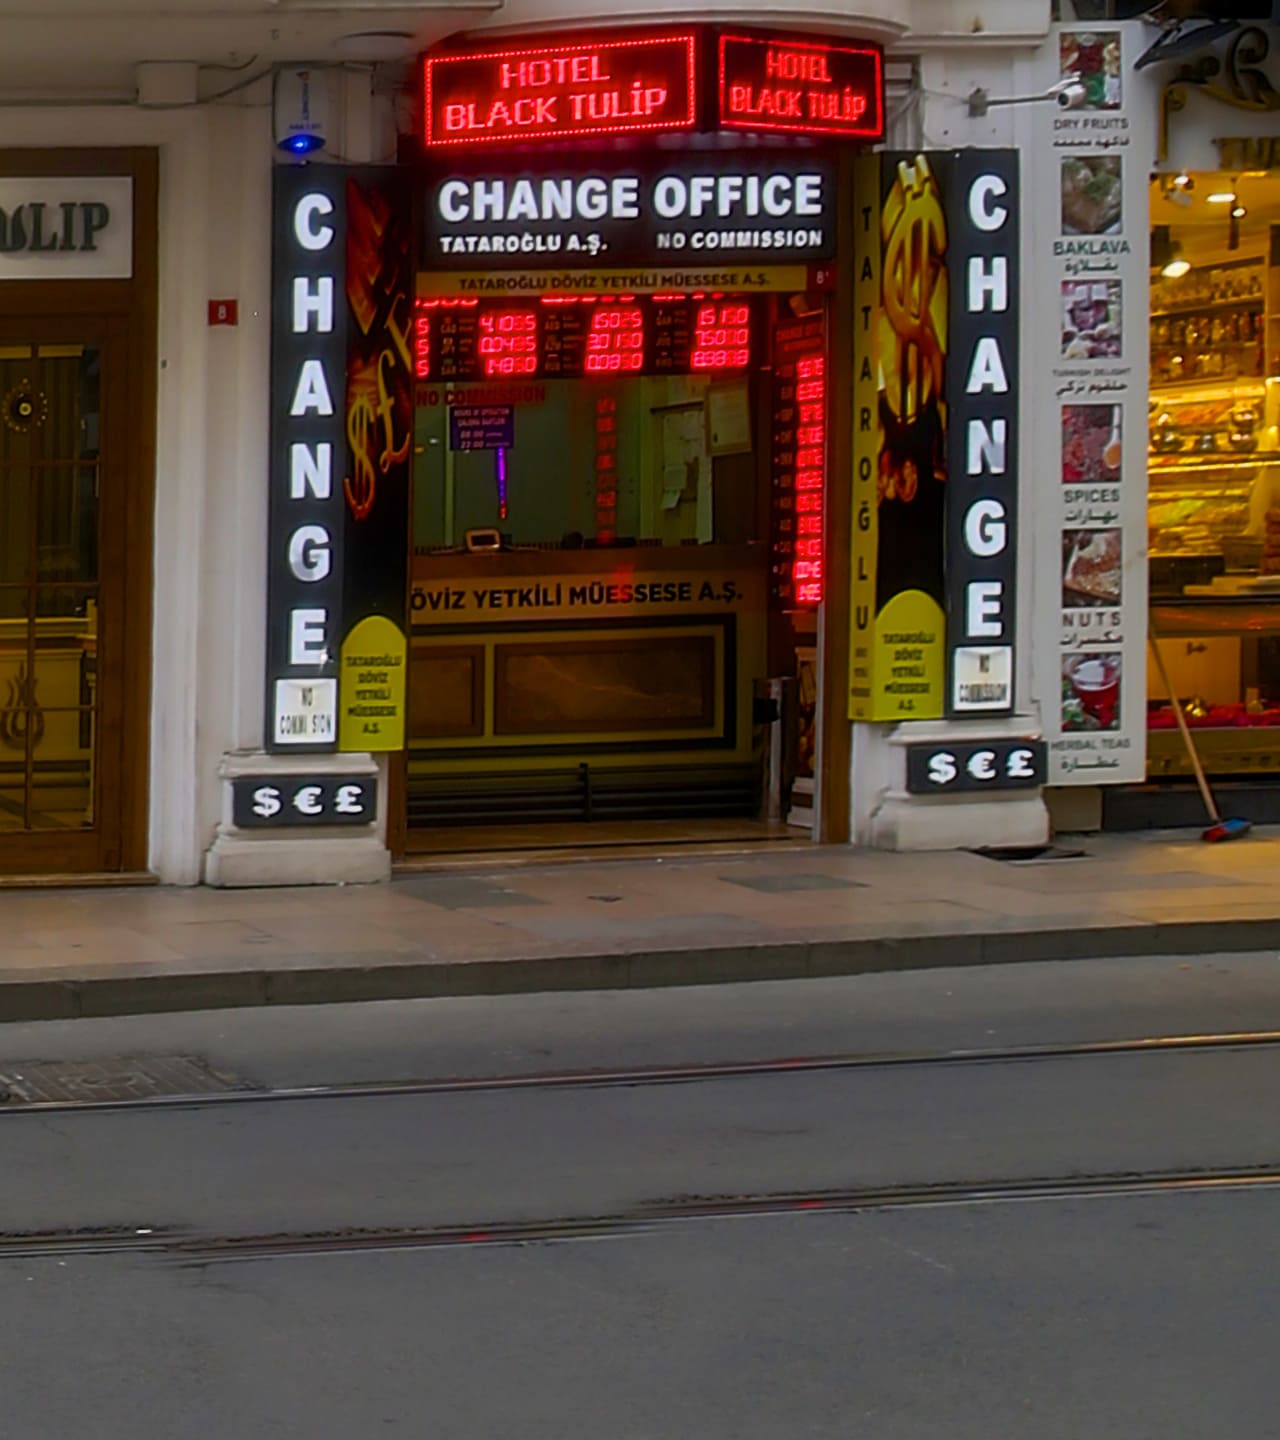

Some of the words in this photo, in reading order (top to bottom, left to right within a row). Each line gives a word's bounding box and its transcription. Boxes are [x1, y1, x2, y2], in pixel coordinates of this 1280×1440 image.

[499, 55, 610, 89] HOTEL
[766, 50, 832, 83] HOTEL
[445, 96, 558, 132] BLACK
[729, 86, 802, 118] BLACK
[1053, 119, 1080, 130] DRY
[1083, 118, 1130, 130] FRUITS
[440, 178, 639, 222] CHANGE
[654, 175, 823, 217] OFFICE
[440, 231, 561, 254] TATAROĞLU
[658, 232, 685, 250] NO
[691, 229, 822, 249] COMMISSION
[1053, 240, 1130, 255] BAKLAVA
[459, 272, 547, 290] TATAROĞLU
[217, 306, 227, 319] 8
[965, 174, 1008, 638] CHANGE
[288, 192, 334, 666] CHANGE
[1063, 489, 1120, 503] SPICES
[410, 589, 465, 611] ÖVİZ
[473, 585, 562, 610] YETKİLİ
[569, 579, 692, 606] MÜESSESE
[1101, 738, 1131, 749] TEAS
[928, 752, 957, 783] $
[967, 751, 996, 780] €
[1007, 749, 1034, 777] £
[252, 787, 281, 817] $
[294, 786, 323, 814] €
[335, 785, 364, 813] £
